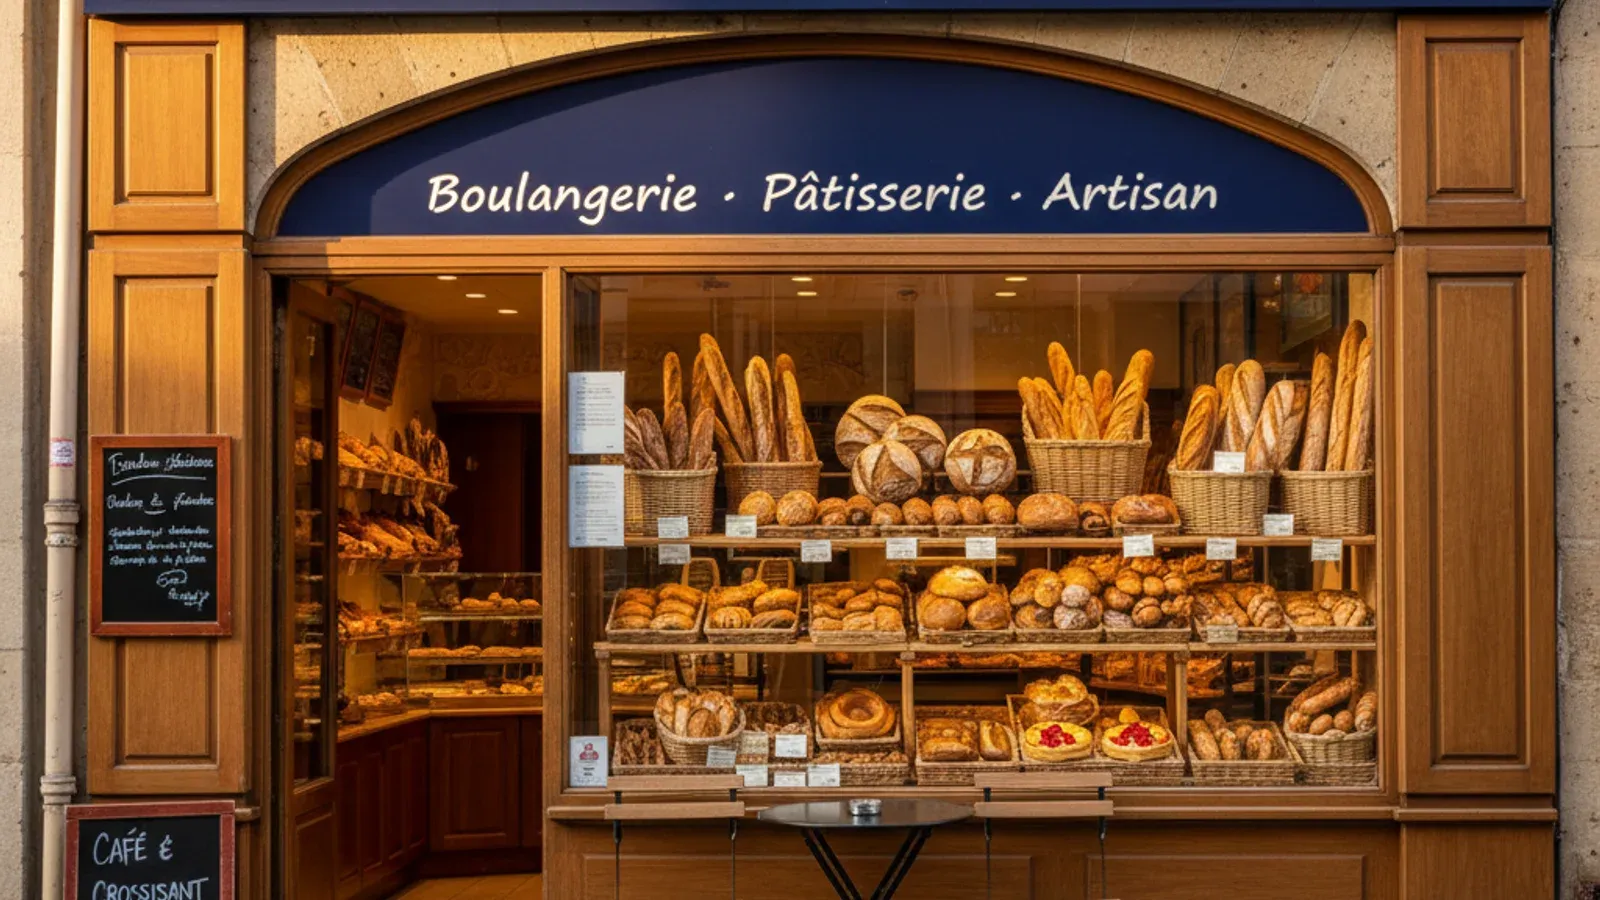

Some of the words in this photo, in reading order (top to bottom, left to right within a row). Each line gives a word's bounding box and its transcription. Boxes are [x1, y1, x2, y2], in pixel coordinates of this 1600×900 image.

[428, 170, 697, 226] Boulangerie
[762, 170, 986, 213] Pâtisserie
[1041, 171, 1219, 211] Artisan
[93, 826, 147, 866] CAFÉ
